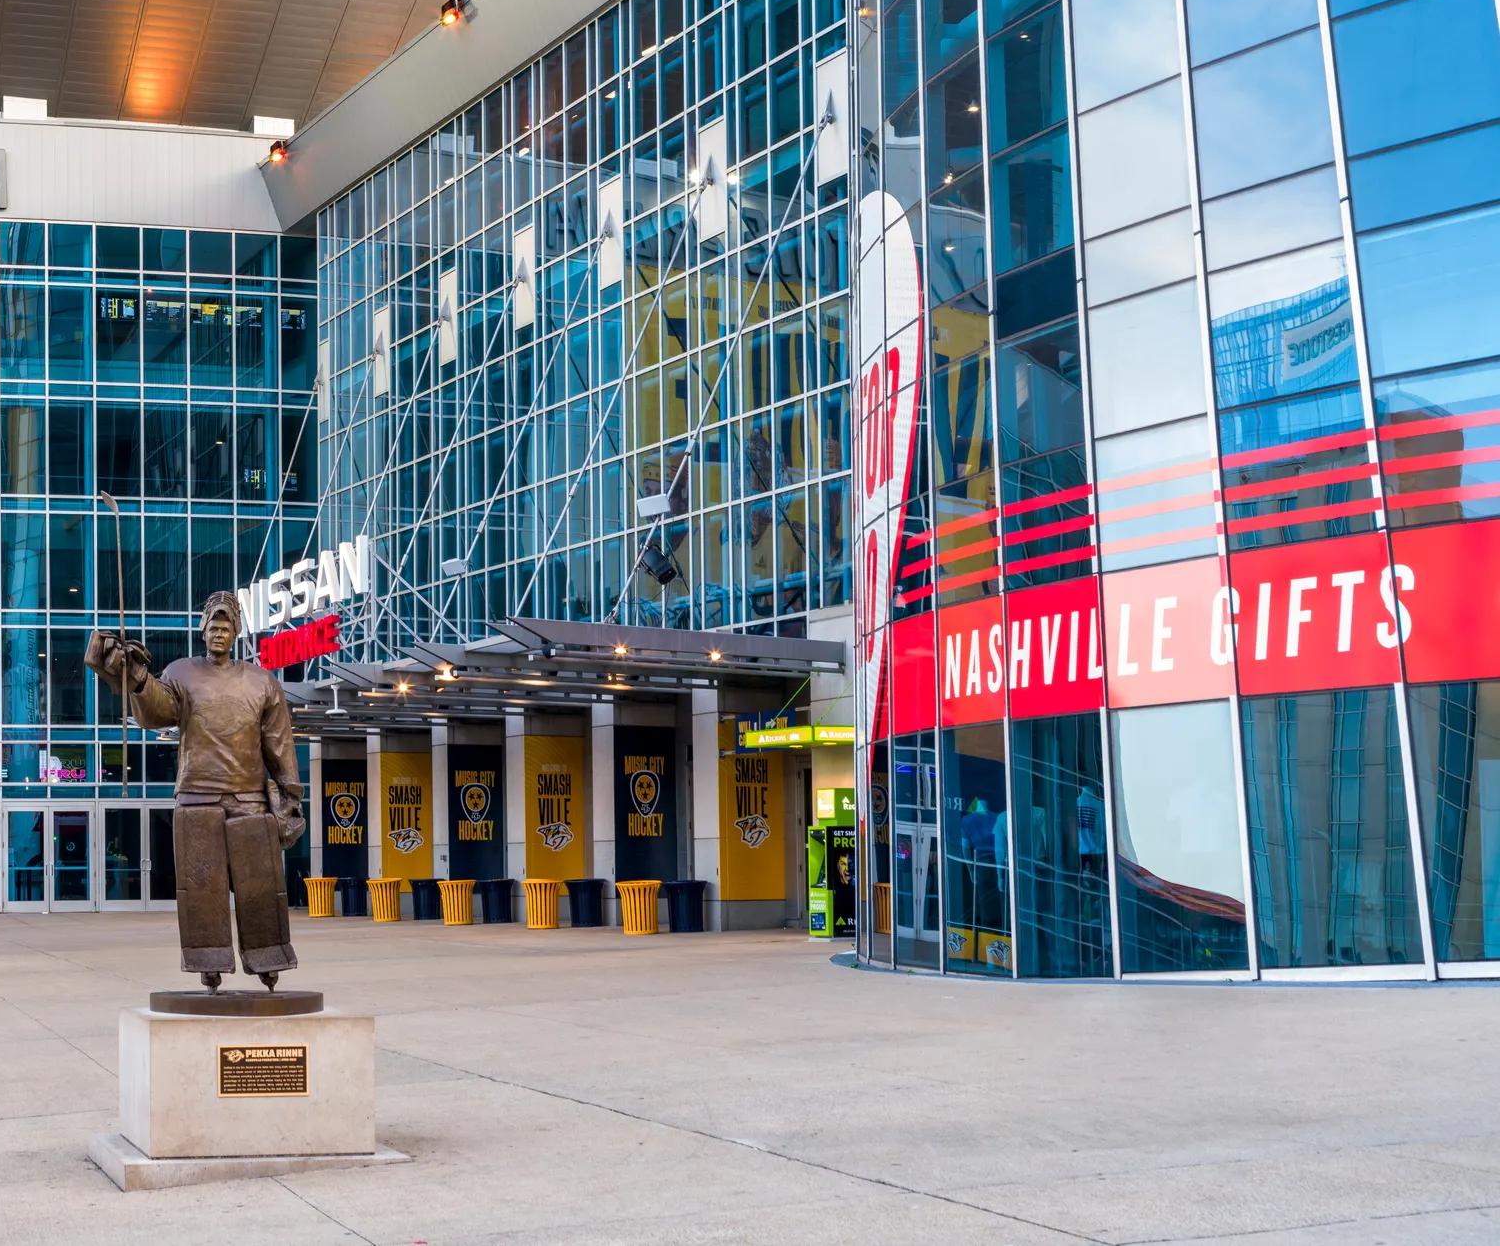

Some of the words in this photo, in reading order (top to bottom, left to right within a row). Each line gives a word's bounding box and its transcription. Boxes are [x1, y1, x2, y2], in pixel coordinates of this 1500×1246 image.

[238, 535, 369, 638] NISSAN
[260, 614, 341, 671] ENTRANCE
[944, 595, 1177, 701] NASHVILLE
[1210, 563, 1416, 668] GIFTS
[625, 755, 648, 775] MUSIC
[649, 756, 665, 775] CITY
[735, 758, 768, 784] SMASH
[325, 782, 348, 797] MUSIC
[349, 781, 365, 798] CITY
[455, 770, 478, 787] MUSIC
[480, 770, 496, 787] CITY
[537, 774, 571, 796] SMASH
[388, 785, 422, 805] SMASH
[736, 787, 768, 818] VILLE
[389, 807, 422, 831] VILLE
[538, 798, 571, 825] VILLE
[328, 825, 363, 844] HOCKEY
[459, 820, 494, 841] HOCKEY
[628, 813, 664, 837] HOCKEY
[245, 1049, 275, 1058] PEKKA
[276, 1048, 303, 1057] RINNE
